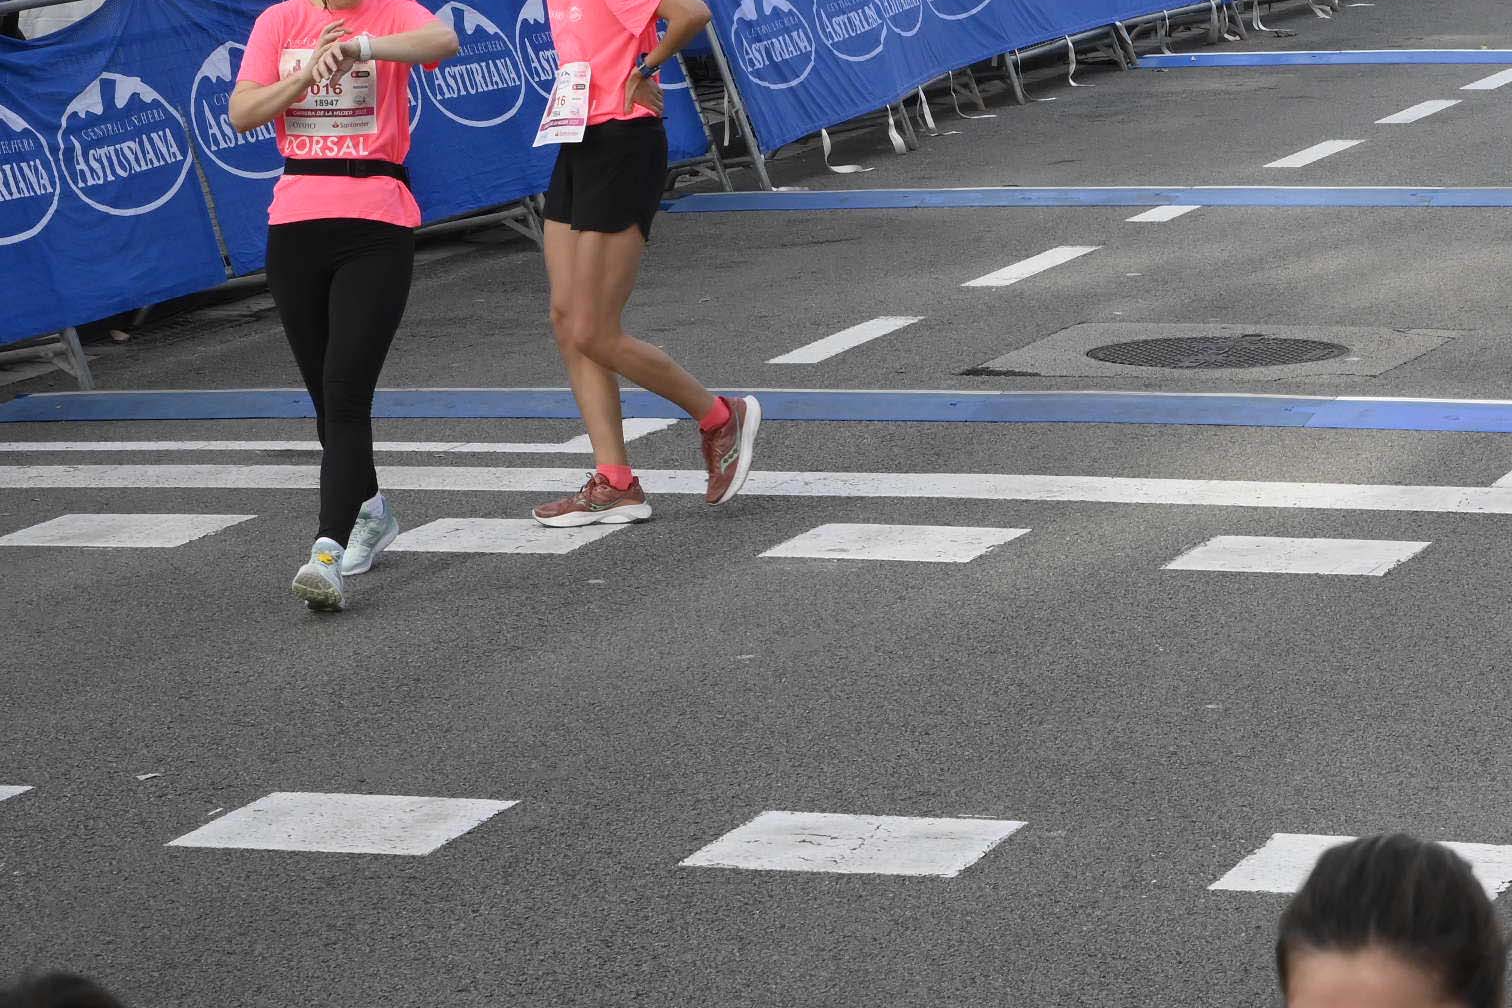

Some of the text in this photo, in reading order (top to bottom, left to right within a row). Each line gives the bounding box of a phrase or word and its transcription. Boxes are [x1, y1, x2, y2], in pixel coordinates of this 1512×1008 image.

[433, 56, 521, 100] ASTURIANA
[314, 99, 339, 107] 18947
[0, 158, 54, 202] RIANA
